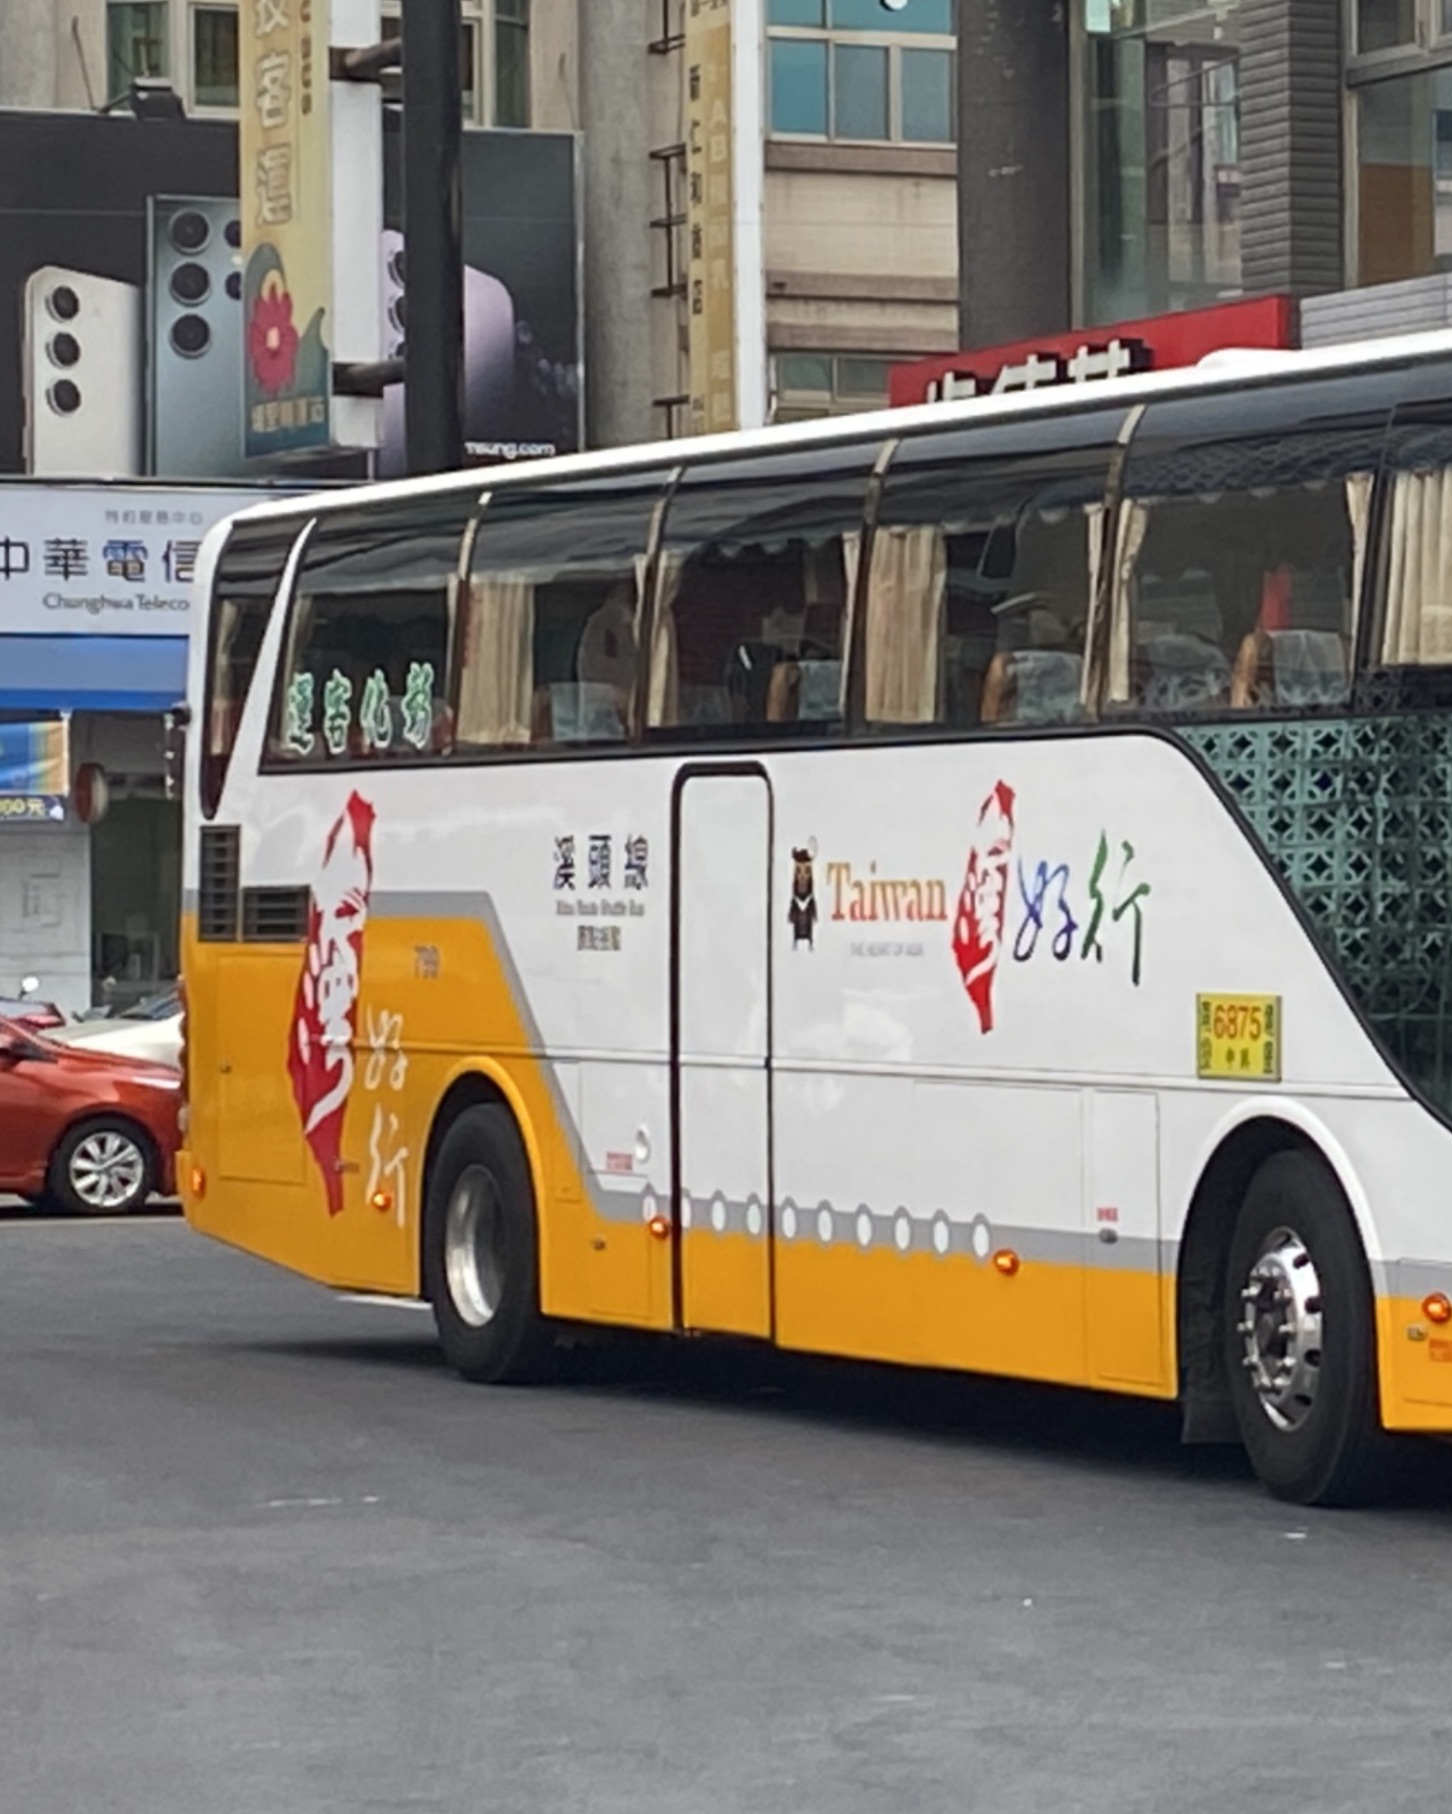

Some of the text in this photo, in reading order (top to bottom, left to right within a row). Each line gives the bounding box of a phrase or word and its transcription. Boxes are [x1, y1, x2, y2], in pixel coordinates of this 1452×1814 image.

[0, 536, 201, 583] 中華電信
[43, 592, 134, 614] Chunghwa
[553, 834, 649, 890] 溪頭線
[826, 860, 948, 922] Taiwan
[1213, 1003, 1262, 1041] 6875
